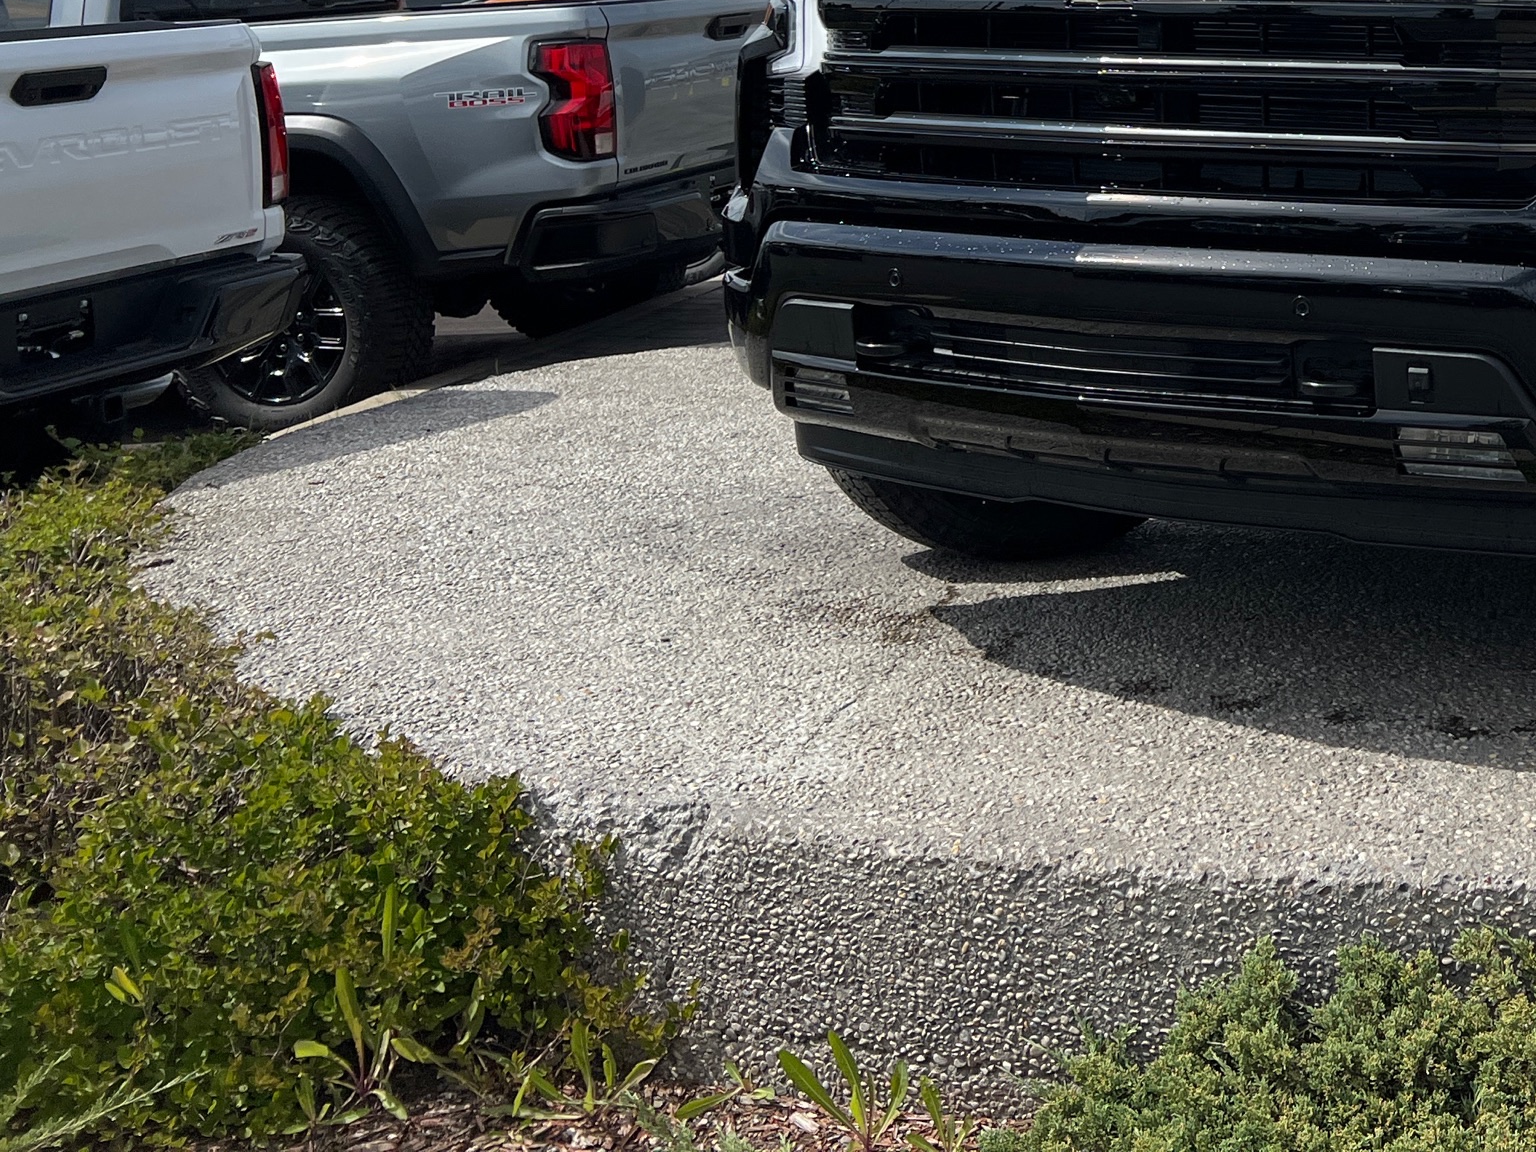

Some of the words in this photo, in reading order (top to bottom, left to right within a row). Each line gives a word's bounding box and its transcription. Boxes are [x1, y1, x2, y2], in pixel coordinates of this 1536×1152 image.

[433, 87, 537, 101] TRAIL
[447, 97, 525, 109] BOSS
[0, 112, 240, 171] VROLET
